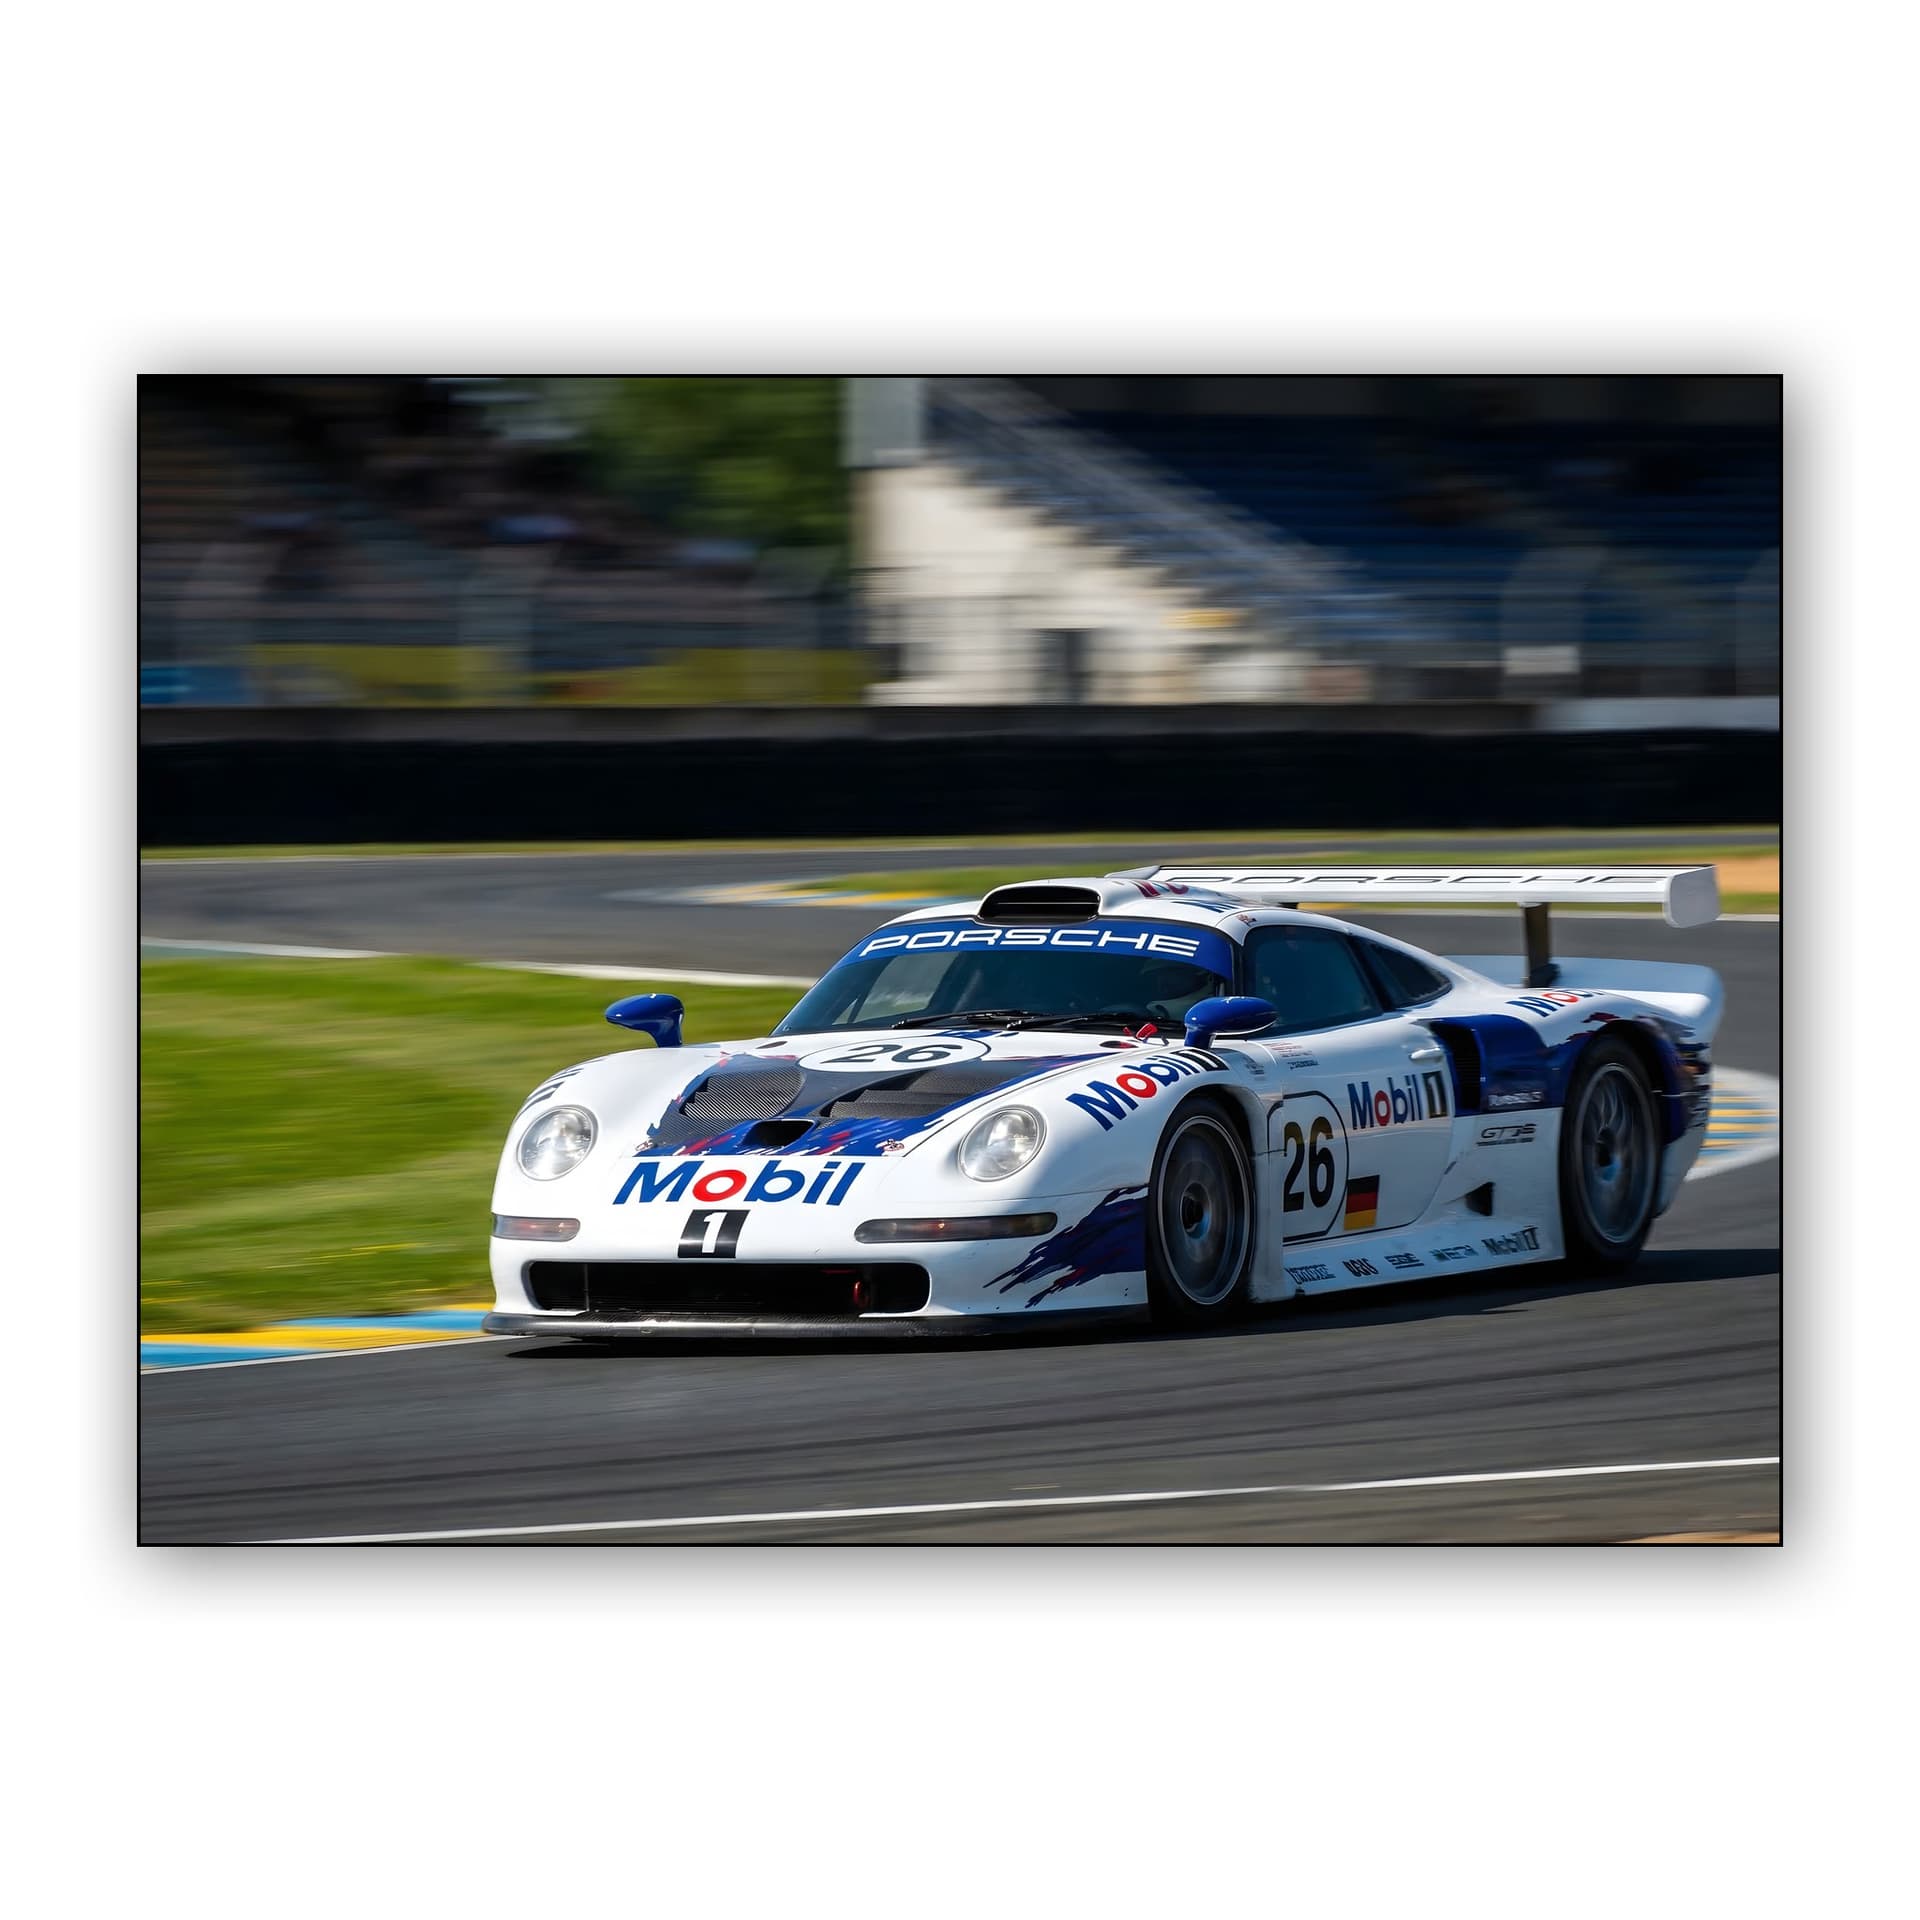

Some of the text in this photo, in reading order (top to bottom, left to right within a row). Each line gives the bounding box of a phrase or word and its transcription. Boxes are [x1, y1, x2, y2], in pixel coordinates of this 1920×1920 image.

[858, 927, 1200, 957] PORSCHE
[819, 1044, 963, 1064] 26
[1065, 1055, 1201, 1132] Mobil
[1347, 1074, 1423, 1130] Mobil
[614, 1160, 866, 1206] Mobil
[1283, 1116, 1335, 1213] 26
